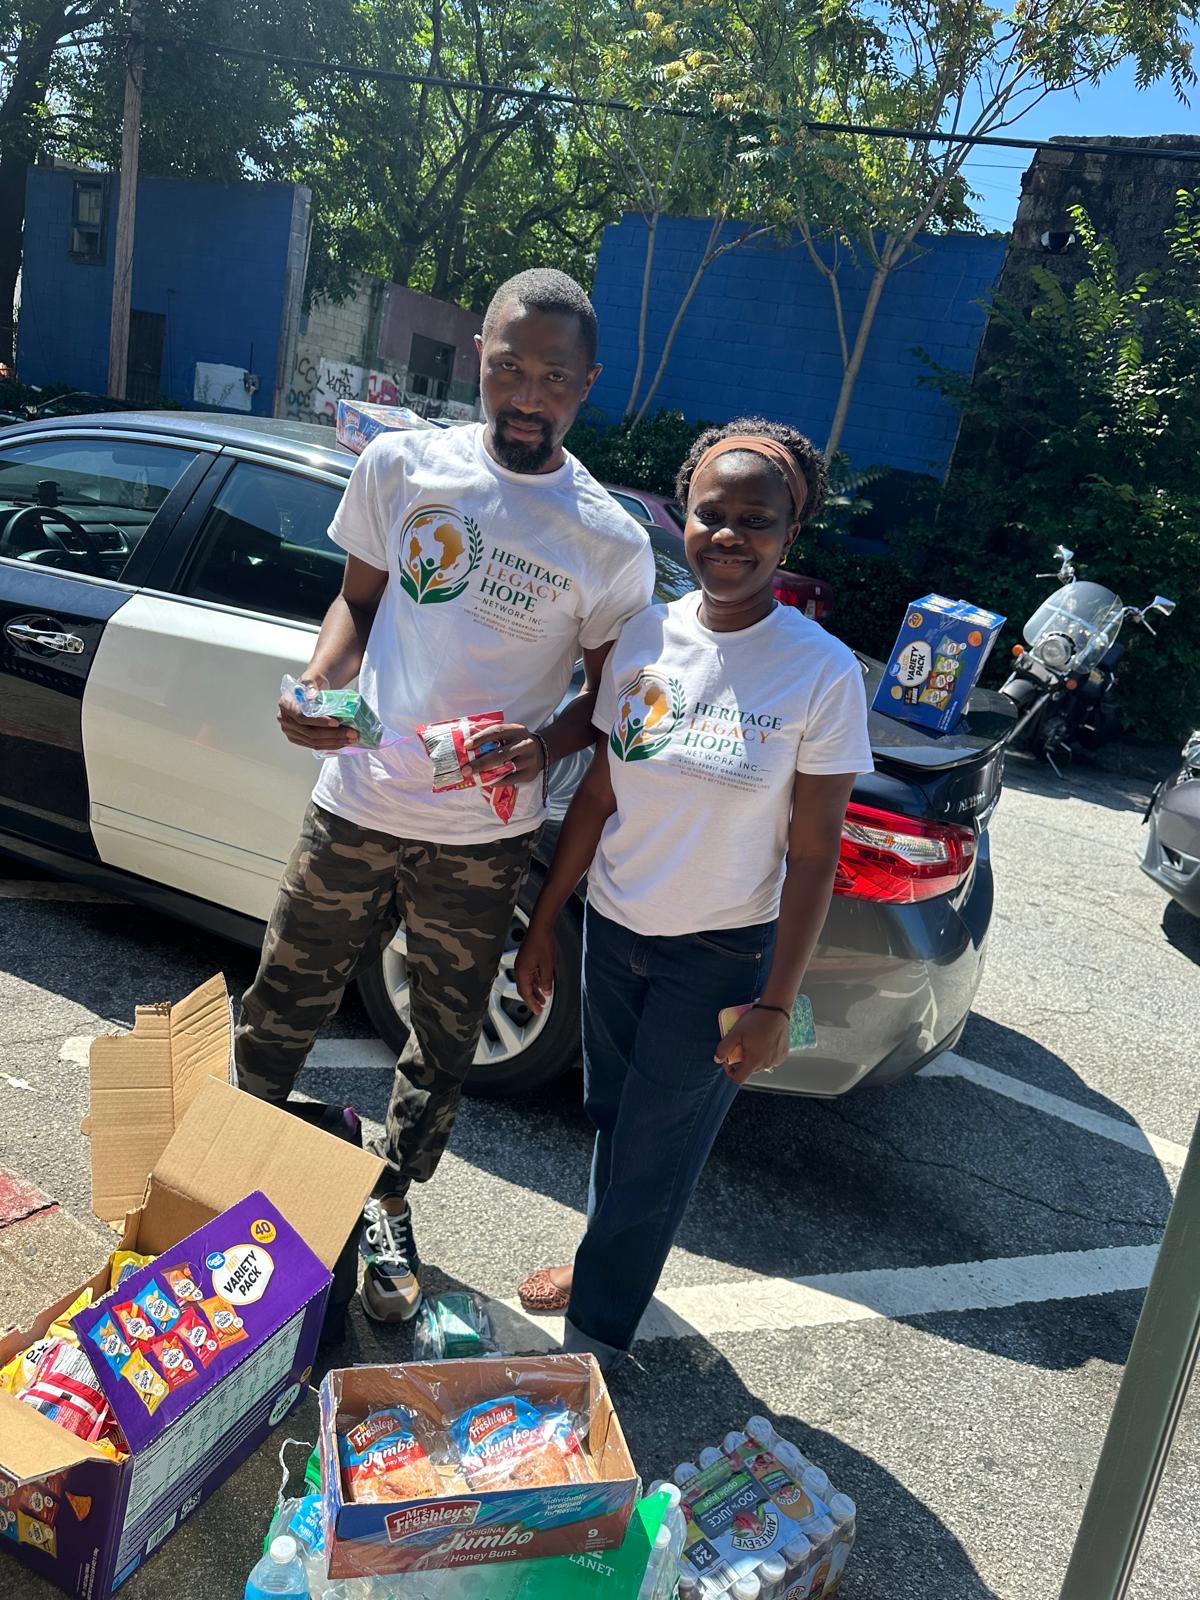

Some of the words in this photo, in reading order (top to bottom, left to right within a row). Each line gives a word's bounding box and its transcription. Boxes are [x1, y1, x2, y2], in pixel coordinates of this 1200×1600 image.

[491, 547, 573, 591] HERITAGE
[486, 563, 562, 602] LEGACY
[480, 577, 538, 613] HOPE
[482, 598, 526, 618] NETWORK
[909, 614, 920, 626] 20
[907, 646, 919, 681] VARIETY
[916, 654, 926, 677] PACK
[694, 702, 783, 730] HERITAGE
[689, 718, 772, 744] LEGACY
[683, 732, 745, 757] HOPE
[686, 750, 735, 766] NETWORK
[255, 1221, 271, 1235] 40
[223, 1250, 257, 1294] VARIETY
[238, 1265, 262, 1297] PACK
[354, 1418, 399, 1447] Freshley
[469, 1407, 513, 1438] Freshley's
[731, 1489, 757, 1510] 100%
[393, 1505, 473, 1533] Freshley's
[406, 1507, 431, 1519] Mrs.
[707, 1505, 734, 1528] JUICE
[436, 1523, 534, 1554] Jumbo
[466, 1527, 506, 1537] ORIGINAL
[587, 1528, 599, 1538] 9
[451, 1552, 488, 1562] Honey
[489, 1549, 517, 1558] Buns
[567, 1553, 616, 1577] LANET
[695, 1549, 712, 1565] 24
